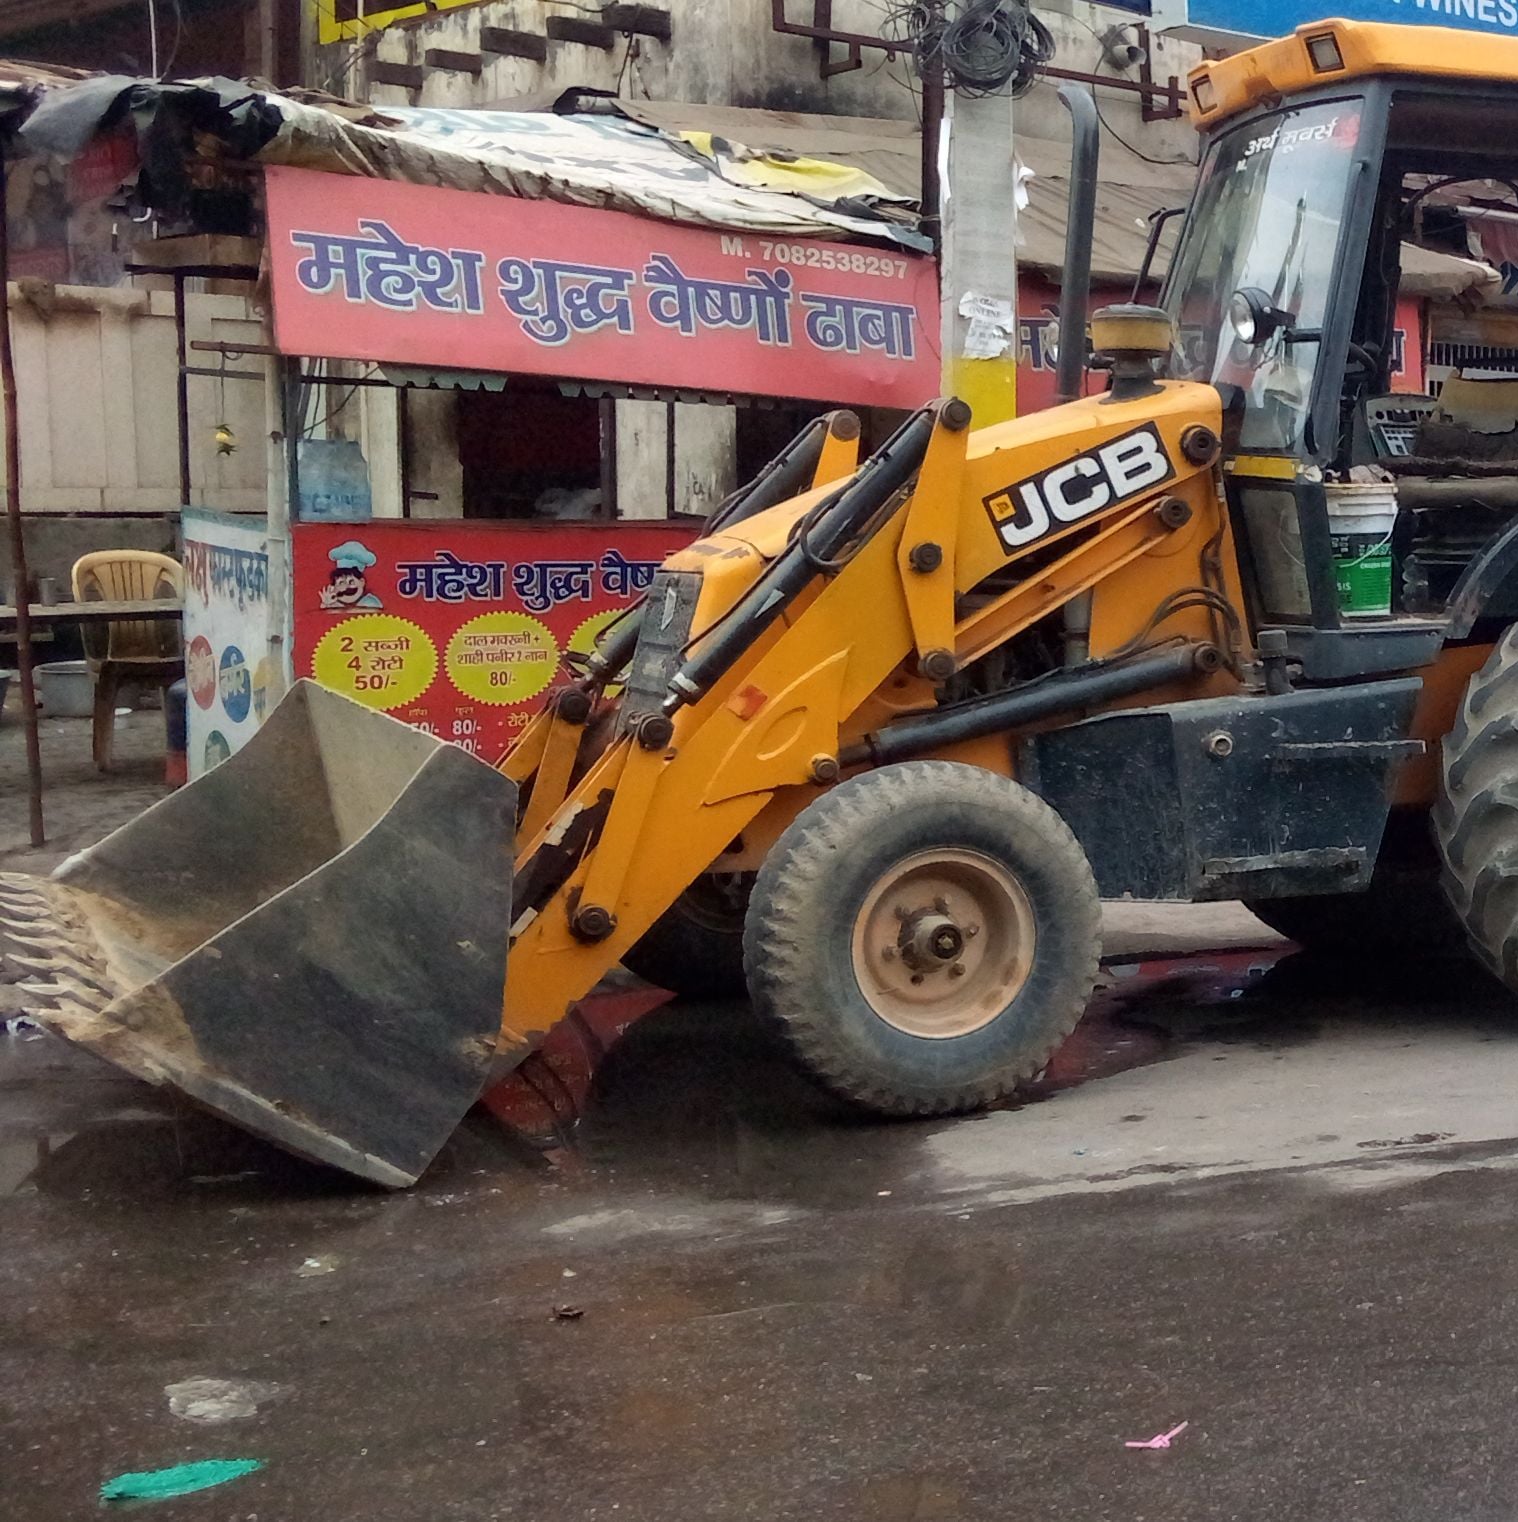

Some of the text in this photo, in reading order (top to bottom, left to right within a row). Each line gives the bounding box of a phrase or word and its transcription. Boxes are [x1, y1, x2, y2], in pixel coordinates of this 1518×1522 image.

[720, 235, 907, 280] M. 7082538297
[289, 218, 486, 315] महेश
[497, 256, 635, 346] शुद्ध
[643, 252, 793, 348] वैष्णों
[800, 290, 917, 361] ढाबा
[999, 430, 1169, 548] JCB
[396, 549, 506, 603] महेश
[511, 560, 596, 613] शुद्ध
[340, 636, 411, 653] 2 सब्जी
[464, 632, 489, 648] दाल
[347, 655, 404, 672] 4 रोटी
[457, 649, 484, 666] शाही
[486, 649, 514, 664] पनीर
[354, 675, 398, 690] 50/-
[490, 671, 517, 686] 80/-
[452, 719, 482, 735] 80/-
